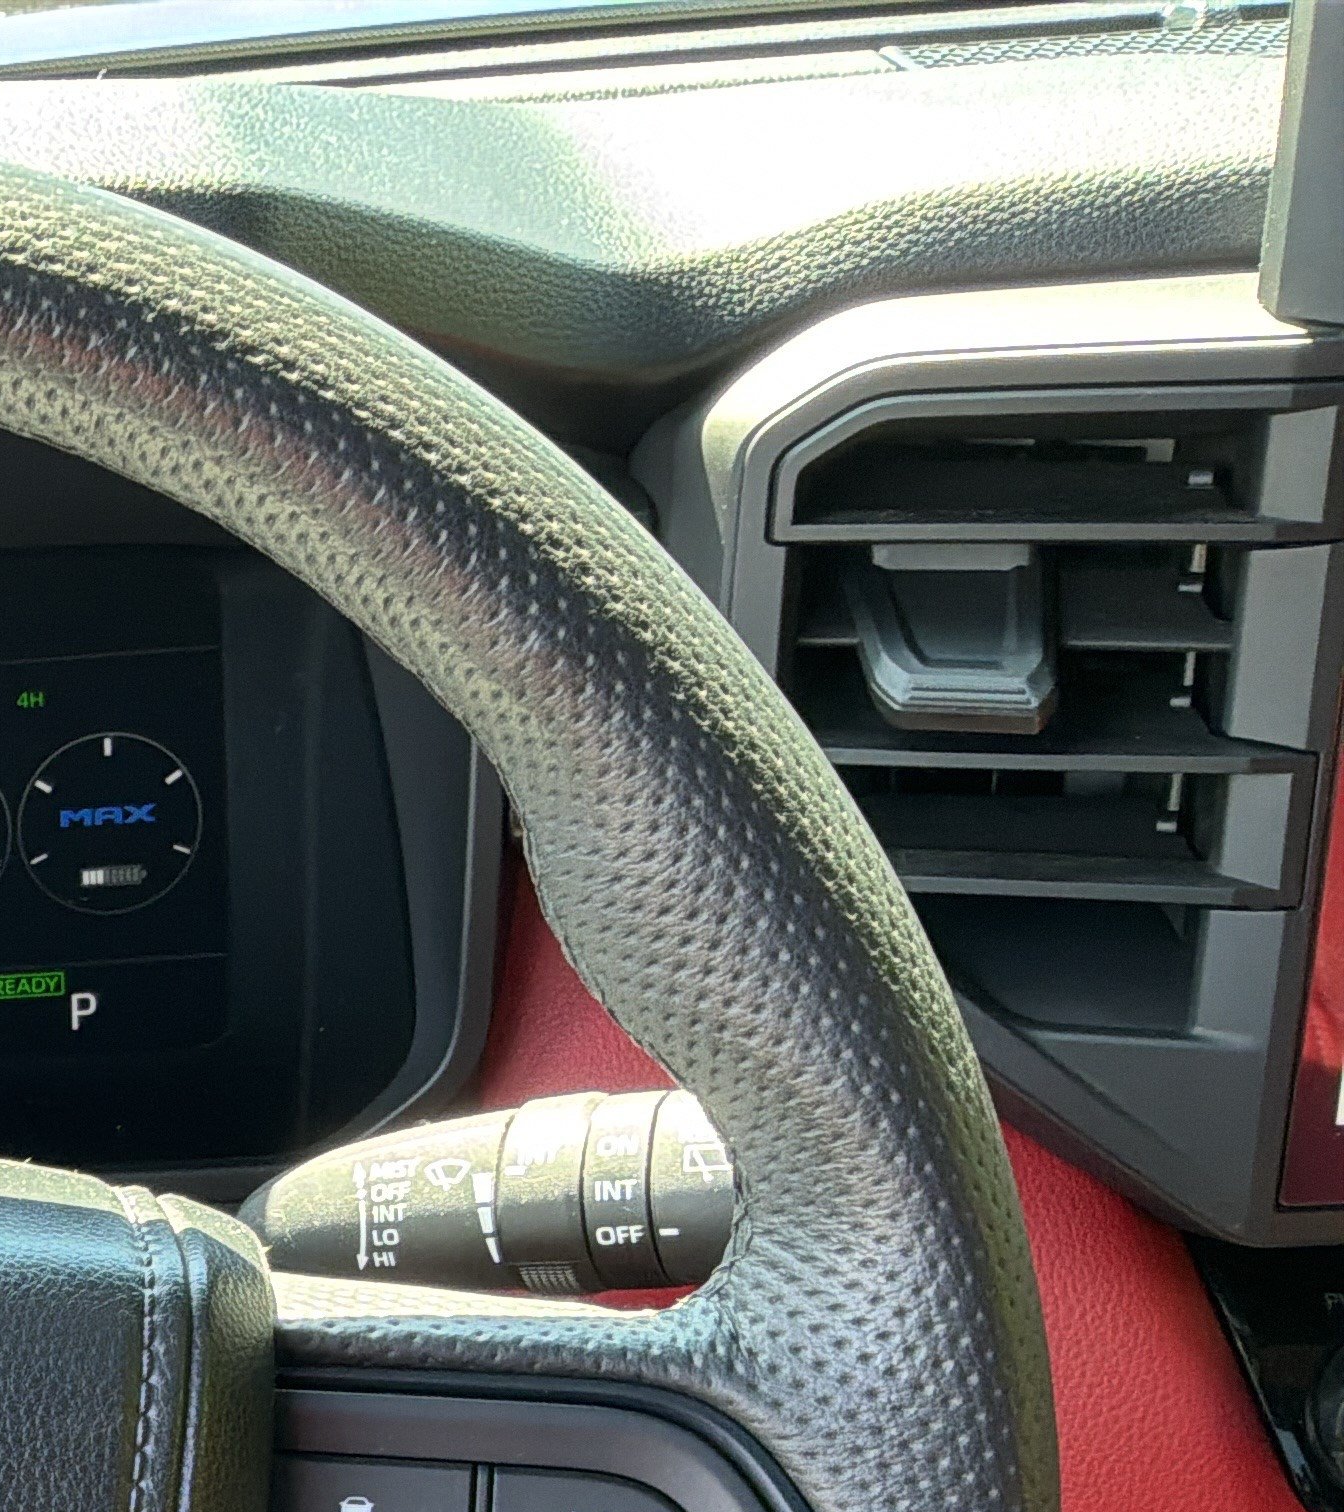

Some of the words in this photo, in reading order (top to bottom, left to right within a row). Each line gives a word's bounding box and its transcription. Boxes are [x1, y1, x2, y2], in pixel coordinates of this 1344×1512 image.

[16, 692, 45, 709] 4H
[59, 803, 156, 827] MAX
[70, 992, 98, 1031] P
[596, 1134, 640, 1157] ON
[370, 1181, 412, 1202] OFF
[593, 1178, 638, 1201] INT
[372, 1203, 408, 1223] INT
[372, 1228, 400, 1246] LO
[595, 1224, 647, 1246] OFF
[372, 1251, 396, 1268] HI
